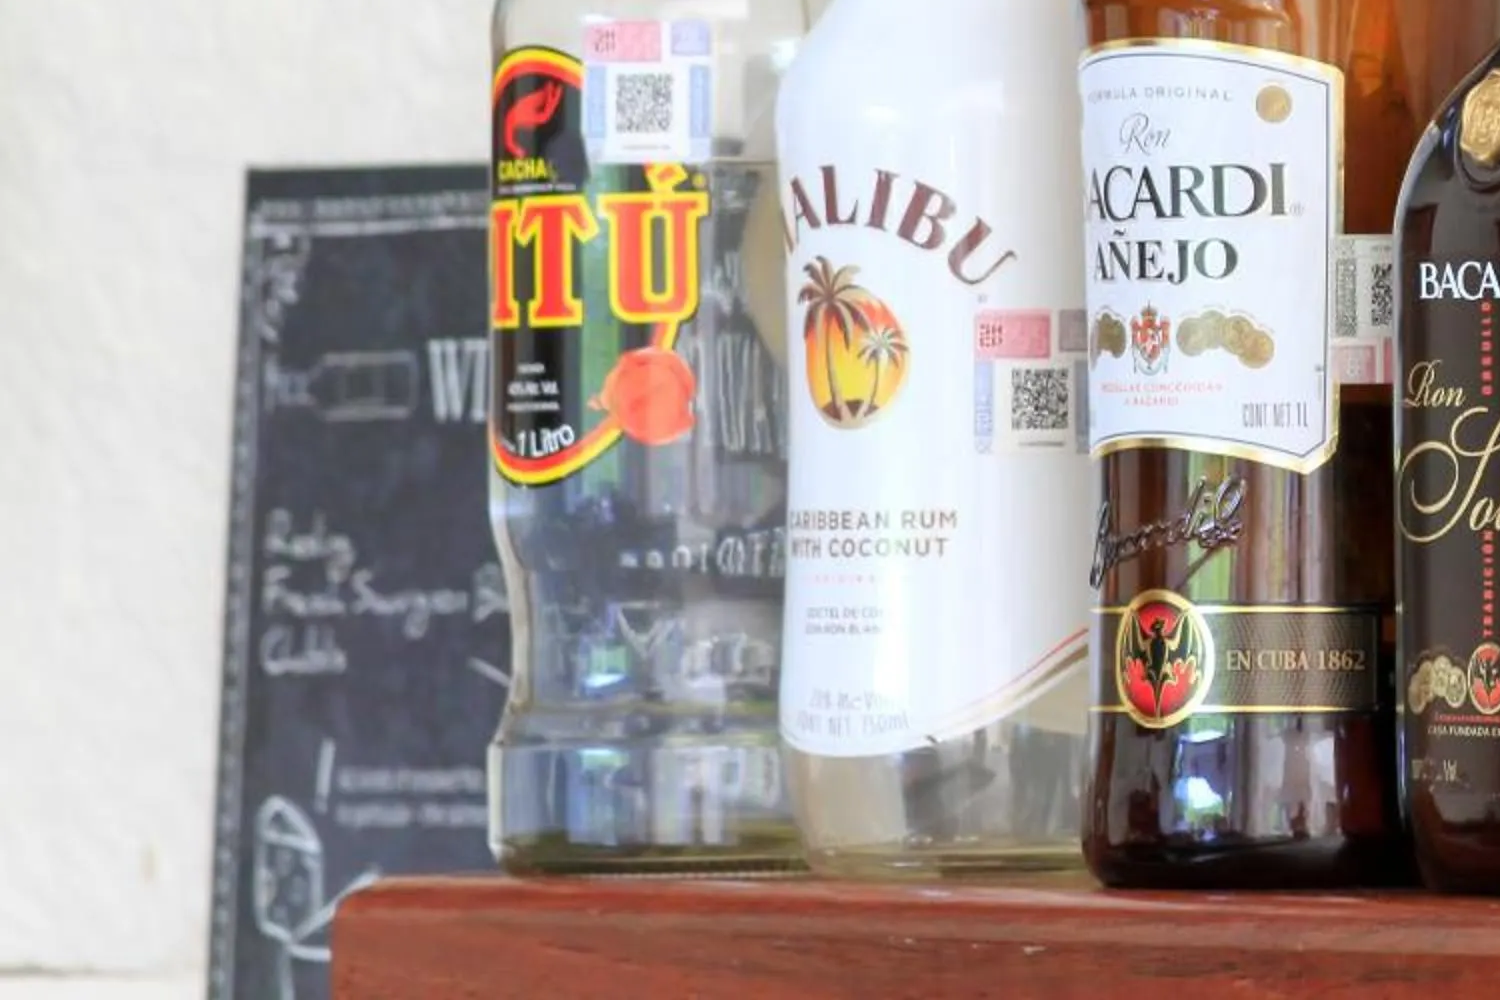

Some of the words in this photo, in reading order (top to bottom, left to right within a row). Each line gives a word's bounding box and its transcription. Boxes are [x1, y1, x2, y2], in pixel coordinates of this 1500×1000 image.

[1144, 86, 1233, 103] ORIGINAL
[1119, 112, 1172, 156] Ron
[1087, 162, 1288, 222] ACARDI
[492, 163, 708, 328] ITÚ
[782, 163, 1018, 286] ALIBU
[1095, 229, 1239, 286] AÑEJO
[1404, 359, 1467, 408] Ron
[789, 510, 890, 531] CARIBBEAN
[901, 509, 959, 530] RUM
[828, 536, 950, 558] COCONUT
[1226, 650, 1250, 671] EN
[1257, 649, 1309, 671] CUBA
[1317, 649, 1366, 671] 1862
